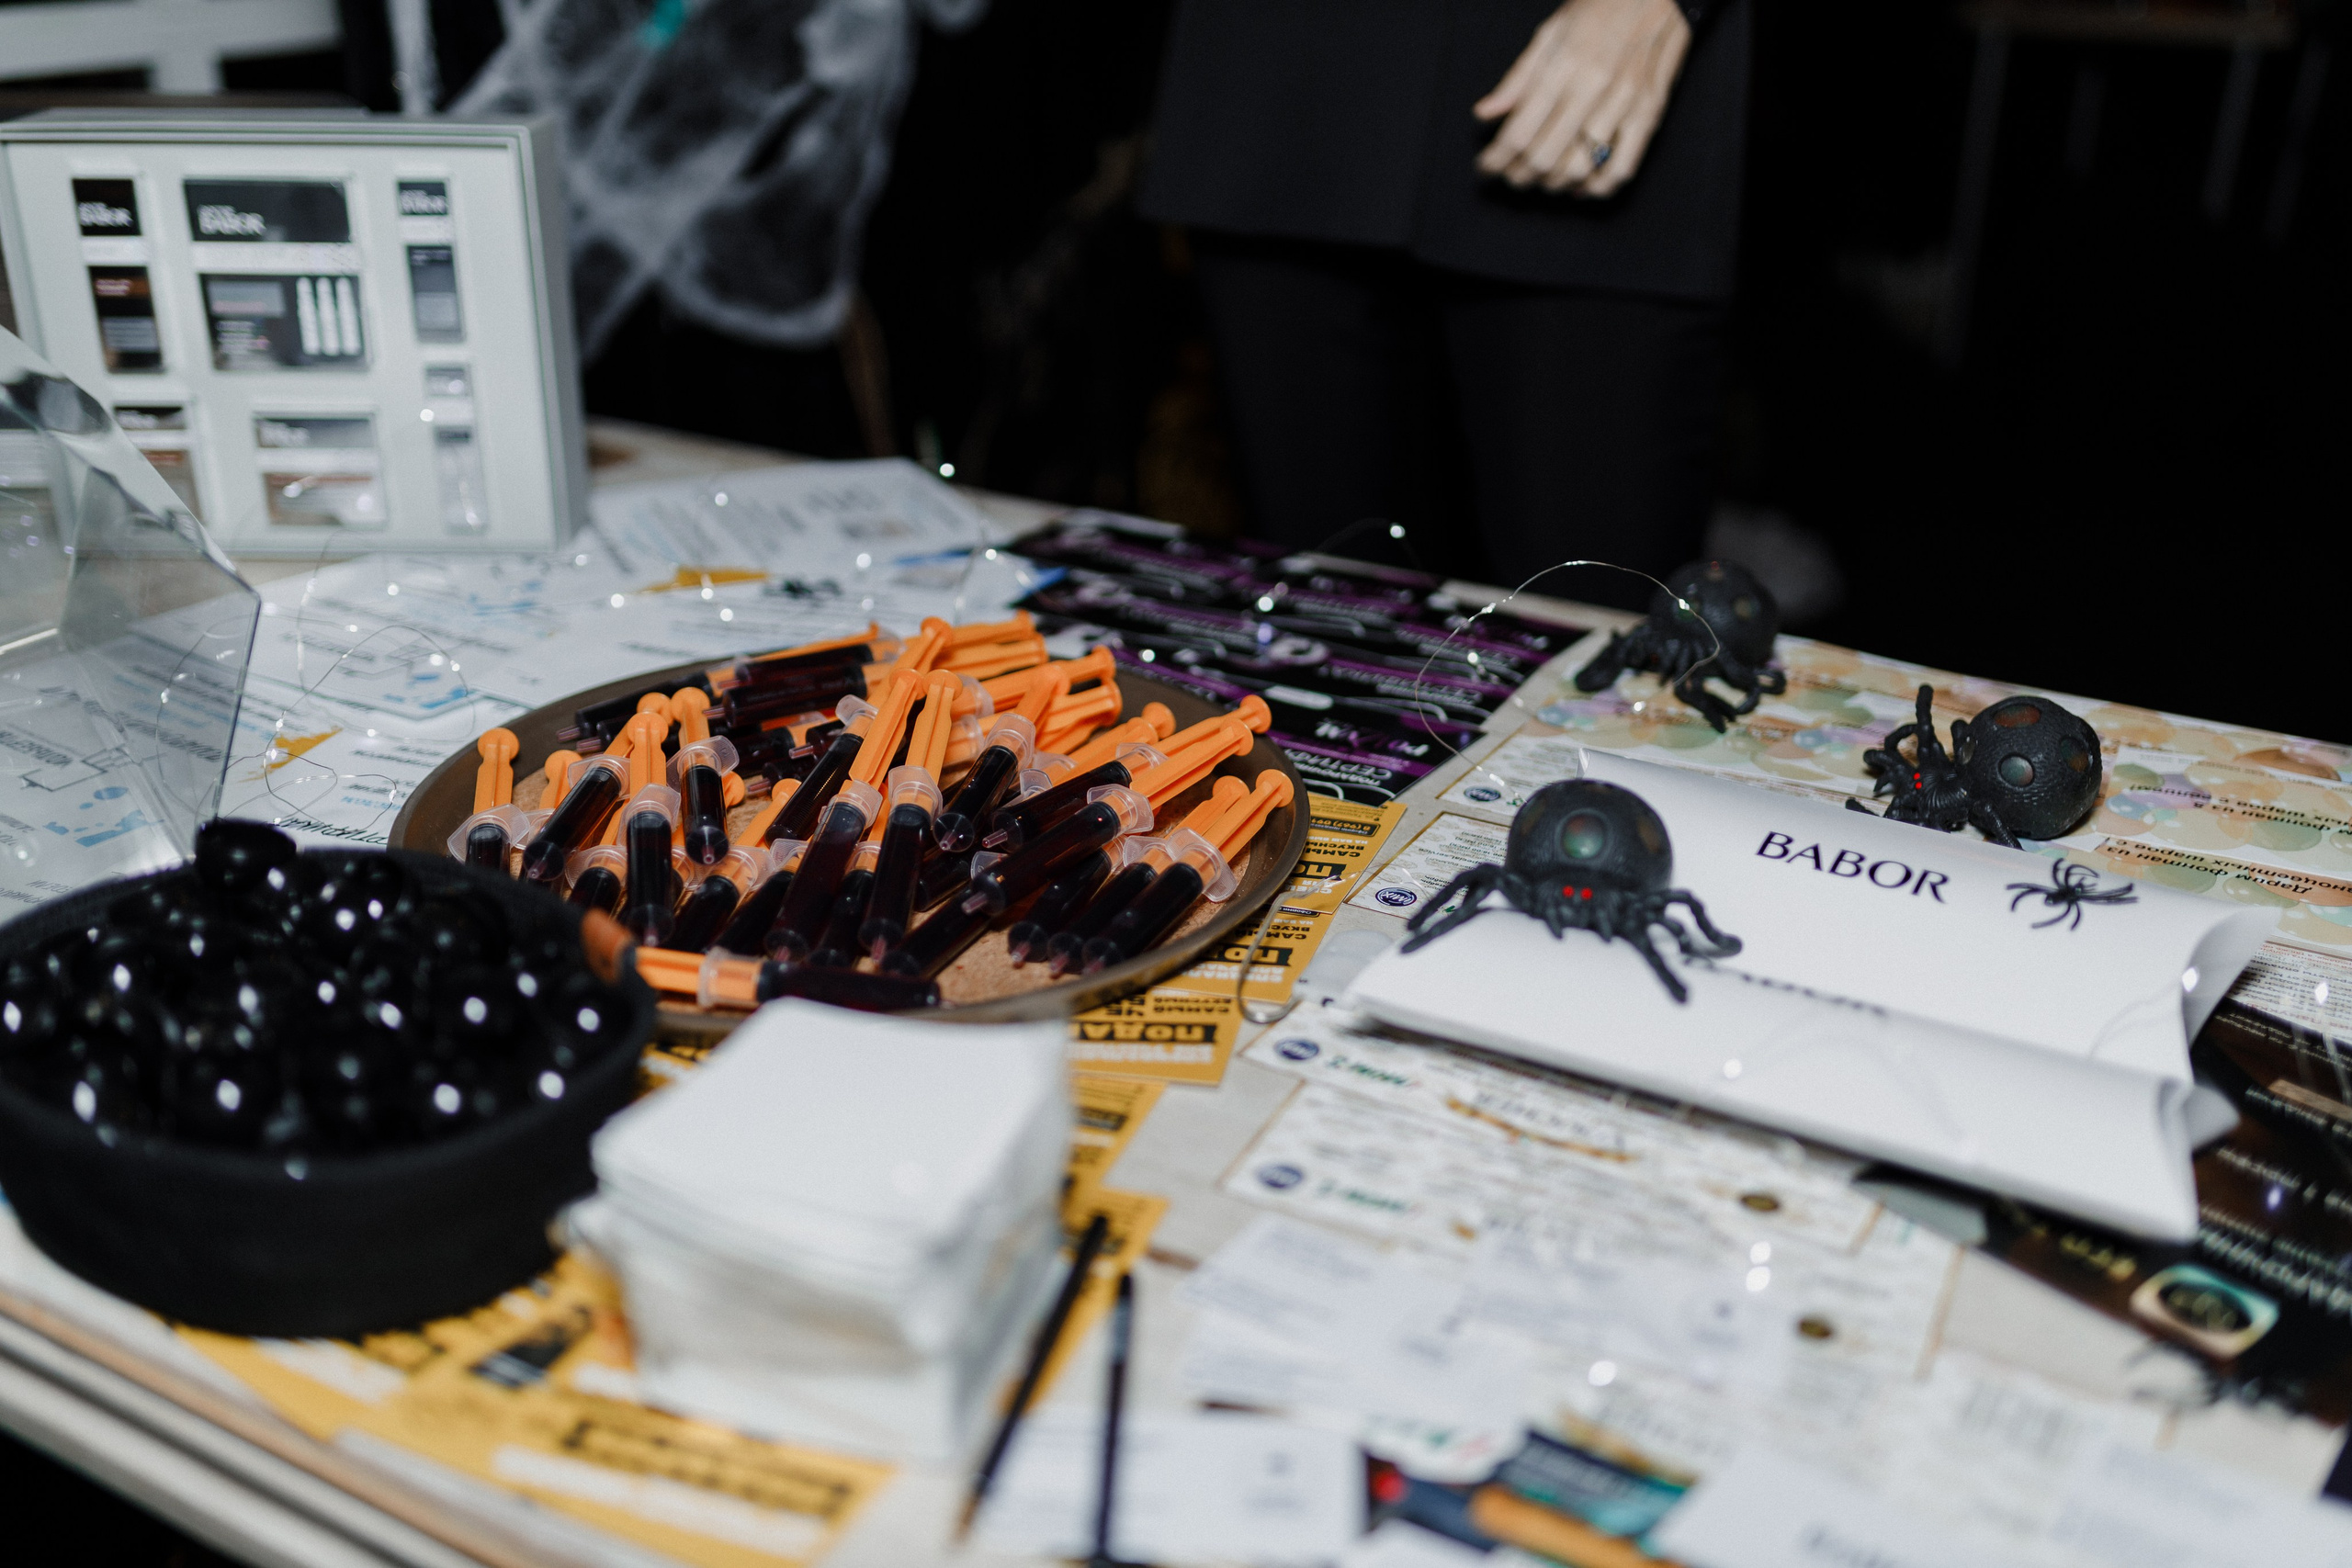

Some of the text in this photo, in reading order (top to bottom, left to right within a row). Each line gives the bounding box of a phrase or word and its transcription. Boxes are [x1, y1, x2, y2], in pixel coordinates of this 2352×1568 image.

[2241, 810, 2331, 831] фонтан
[1304, 848, 1361, 858] САМЫ
[1305, 841, 1365, 851] ВКУСНЫ
[2134, 843, 2205, 863] шаров
[1756, 830, 1950, 904] BABOR
[2107, 847, 2312, 895] Дарим фонтан из
